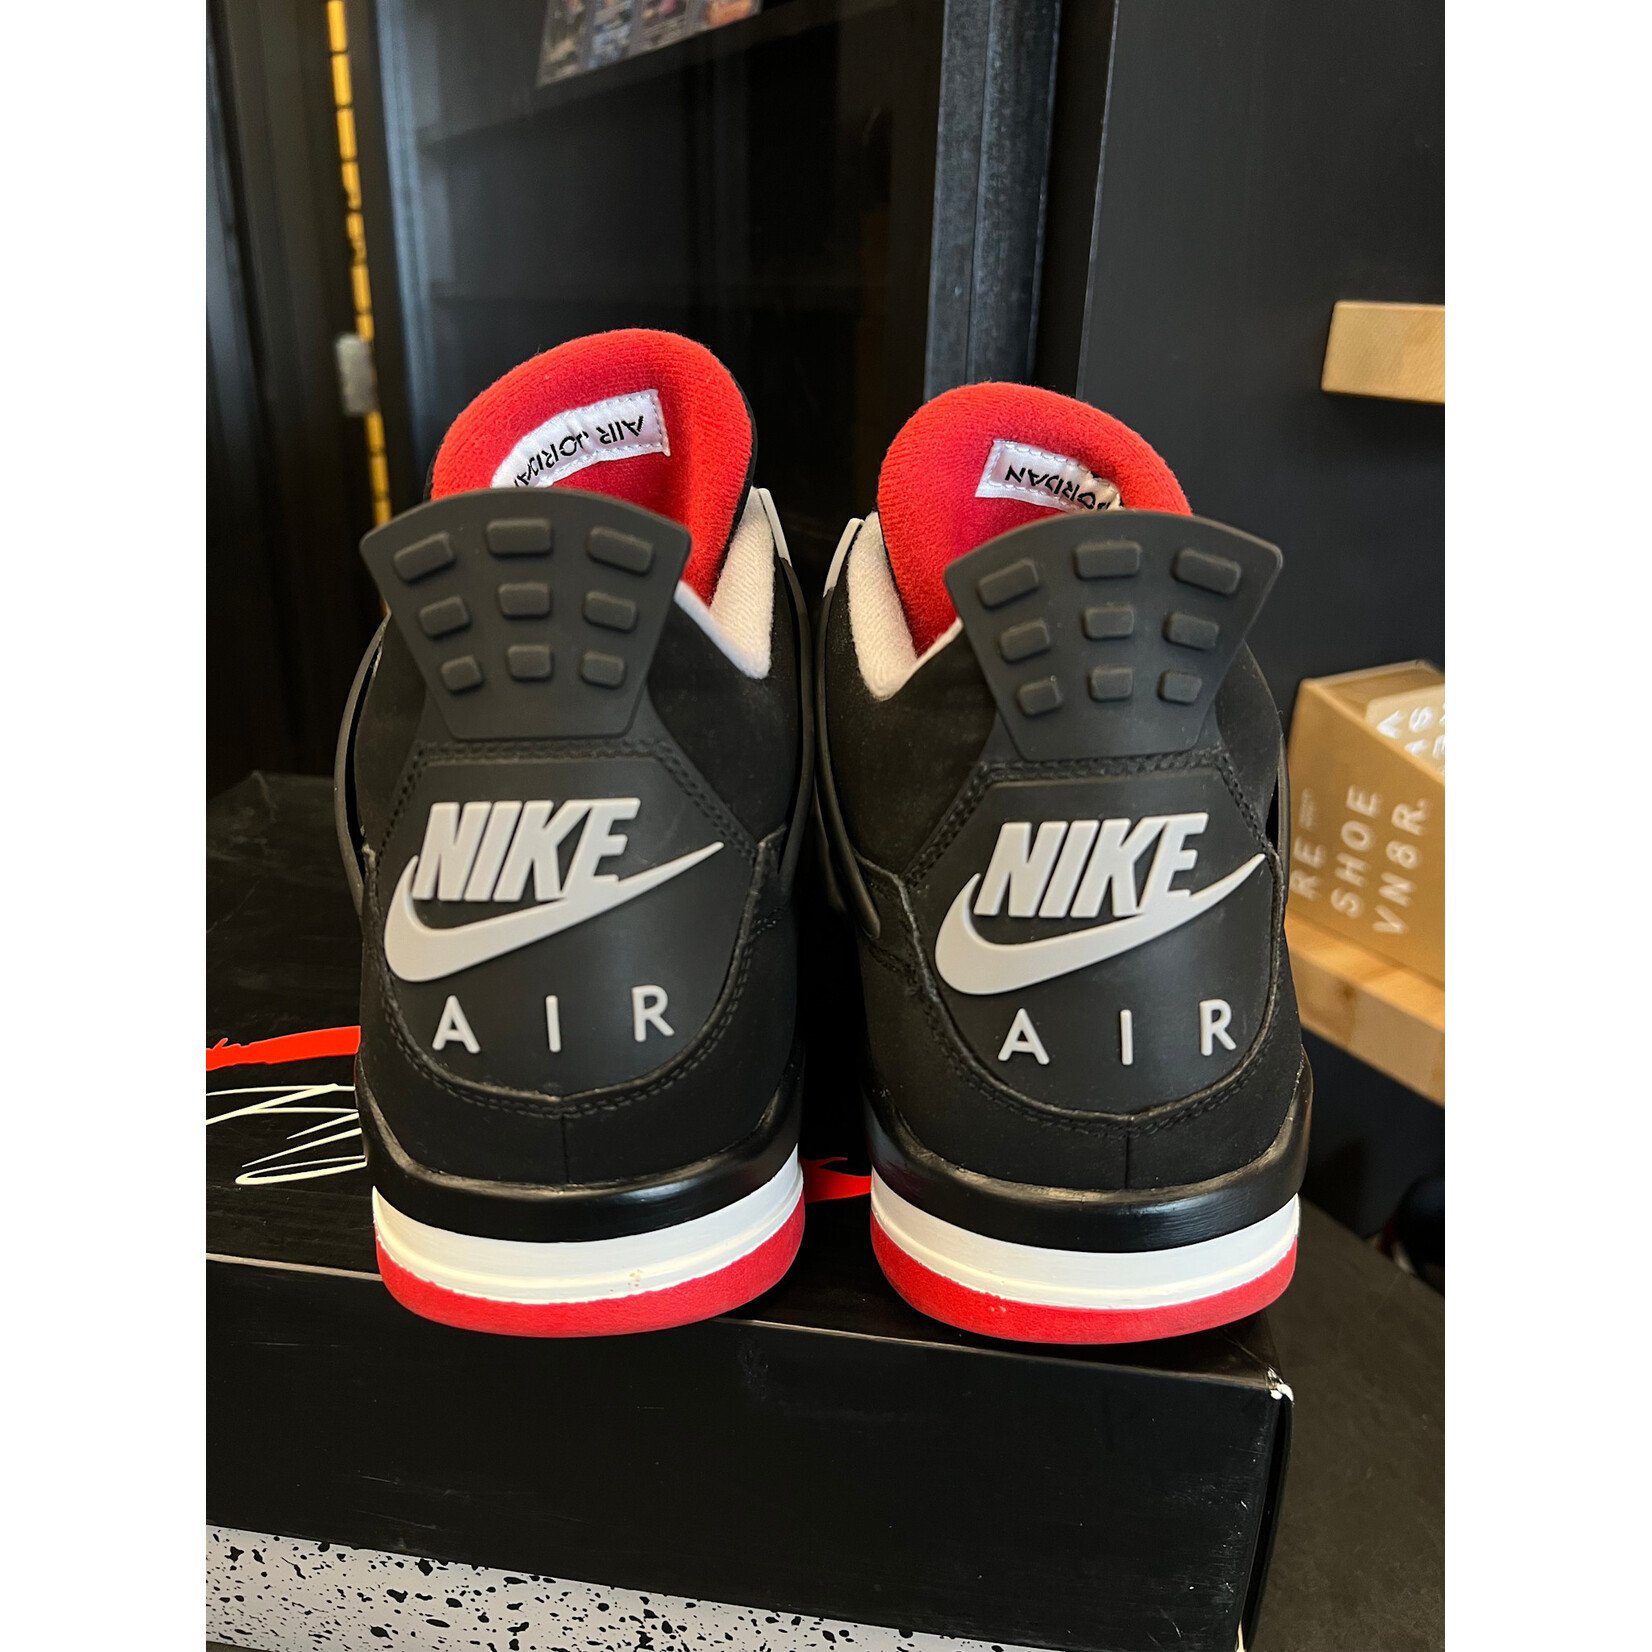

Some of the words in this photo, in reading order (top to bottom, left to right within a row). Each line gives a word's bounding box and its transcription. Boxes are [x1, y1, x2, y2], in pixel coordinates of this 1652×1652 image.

[513, 431, 590, 488] JORDA
[596, 415, 644, 445] AIR
[411, 797, 641, 902] NIKE
[973, 812, 1209, 918] NIKE
[1330, 784, 1381, 920] SHOE
[431, 984, 675, 1054] AIR
[997, 998, 1237, 1066] AIR
